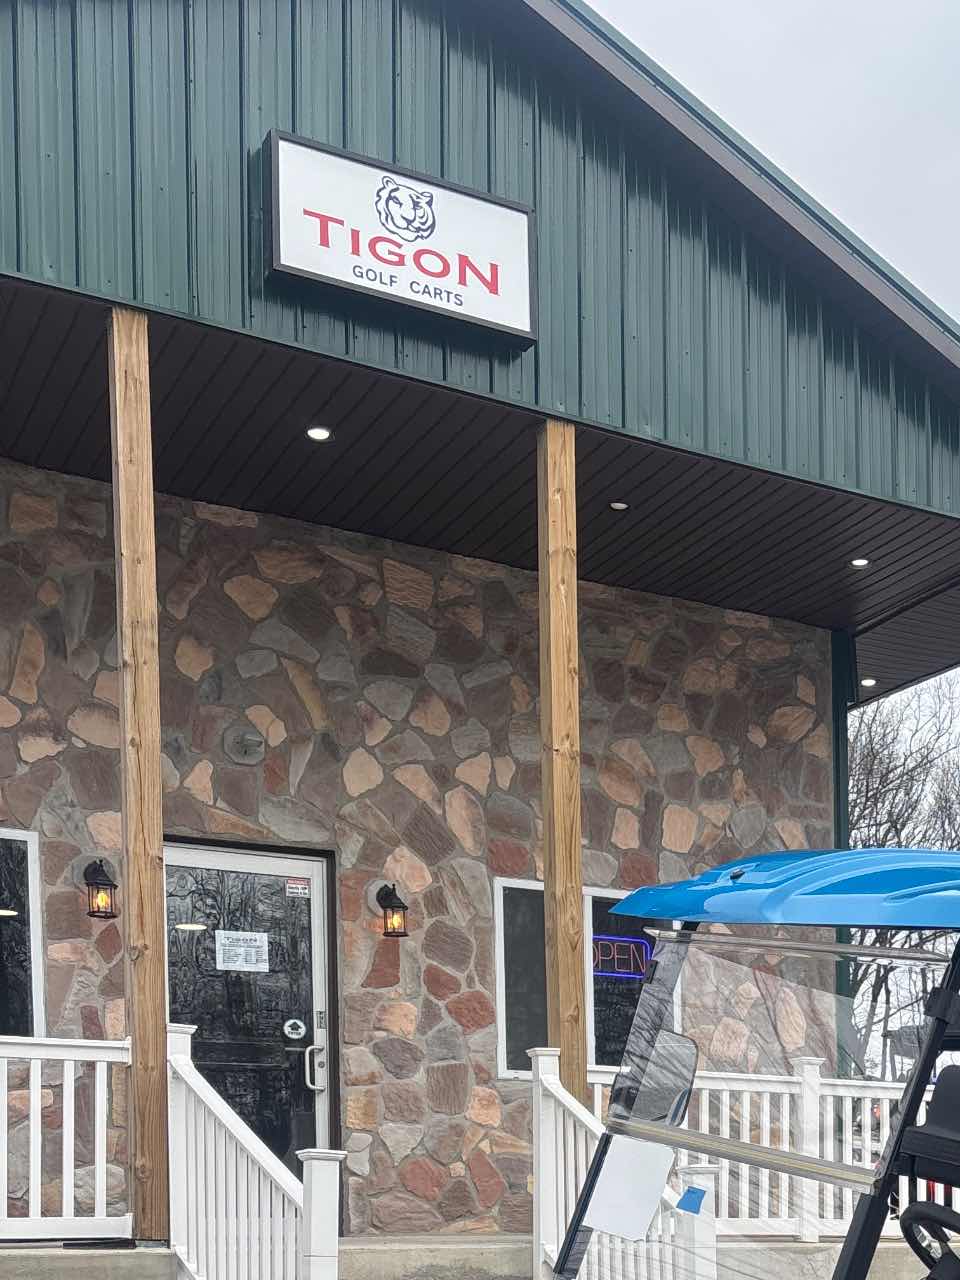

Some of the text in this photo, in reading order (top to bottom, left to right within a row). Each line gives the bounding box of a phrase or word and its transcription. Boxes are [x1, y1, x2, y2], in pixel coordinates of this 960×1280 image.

[302, 208, 501, 296] TIGON
[352, 264, 464, 307] GOLF CARTS
